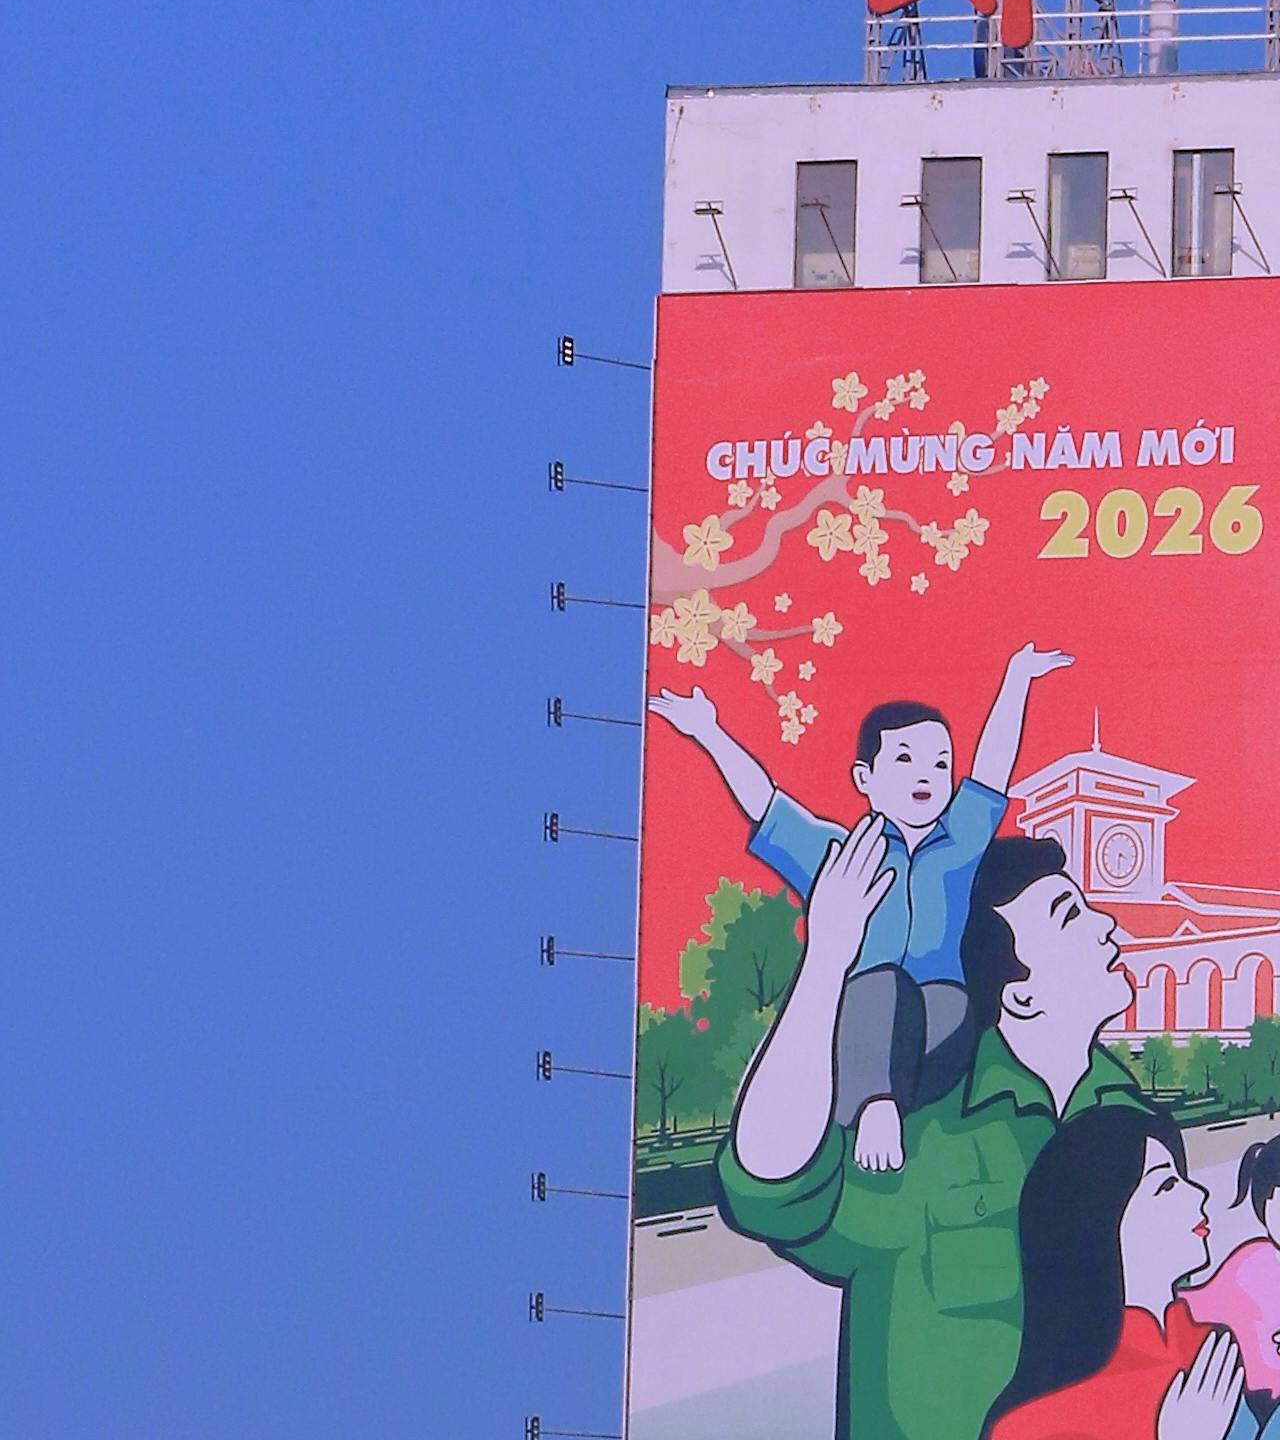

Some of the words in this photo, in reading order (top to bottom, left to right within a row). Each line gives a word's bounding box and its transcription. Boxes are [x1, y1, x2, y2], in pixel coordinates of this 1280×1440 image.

[706, 430, 830, 480] CHÚC
[845, 427, 995, 476] MỪNG
[1011, 424, 1123, 470] NĂM
[1136, 418, 1235, 467] MỚI
[1037, 484, 1263, 559] 2026
